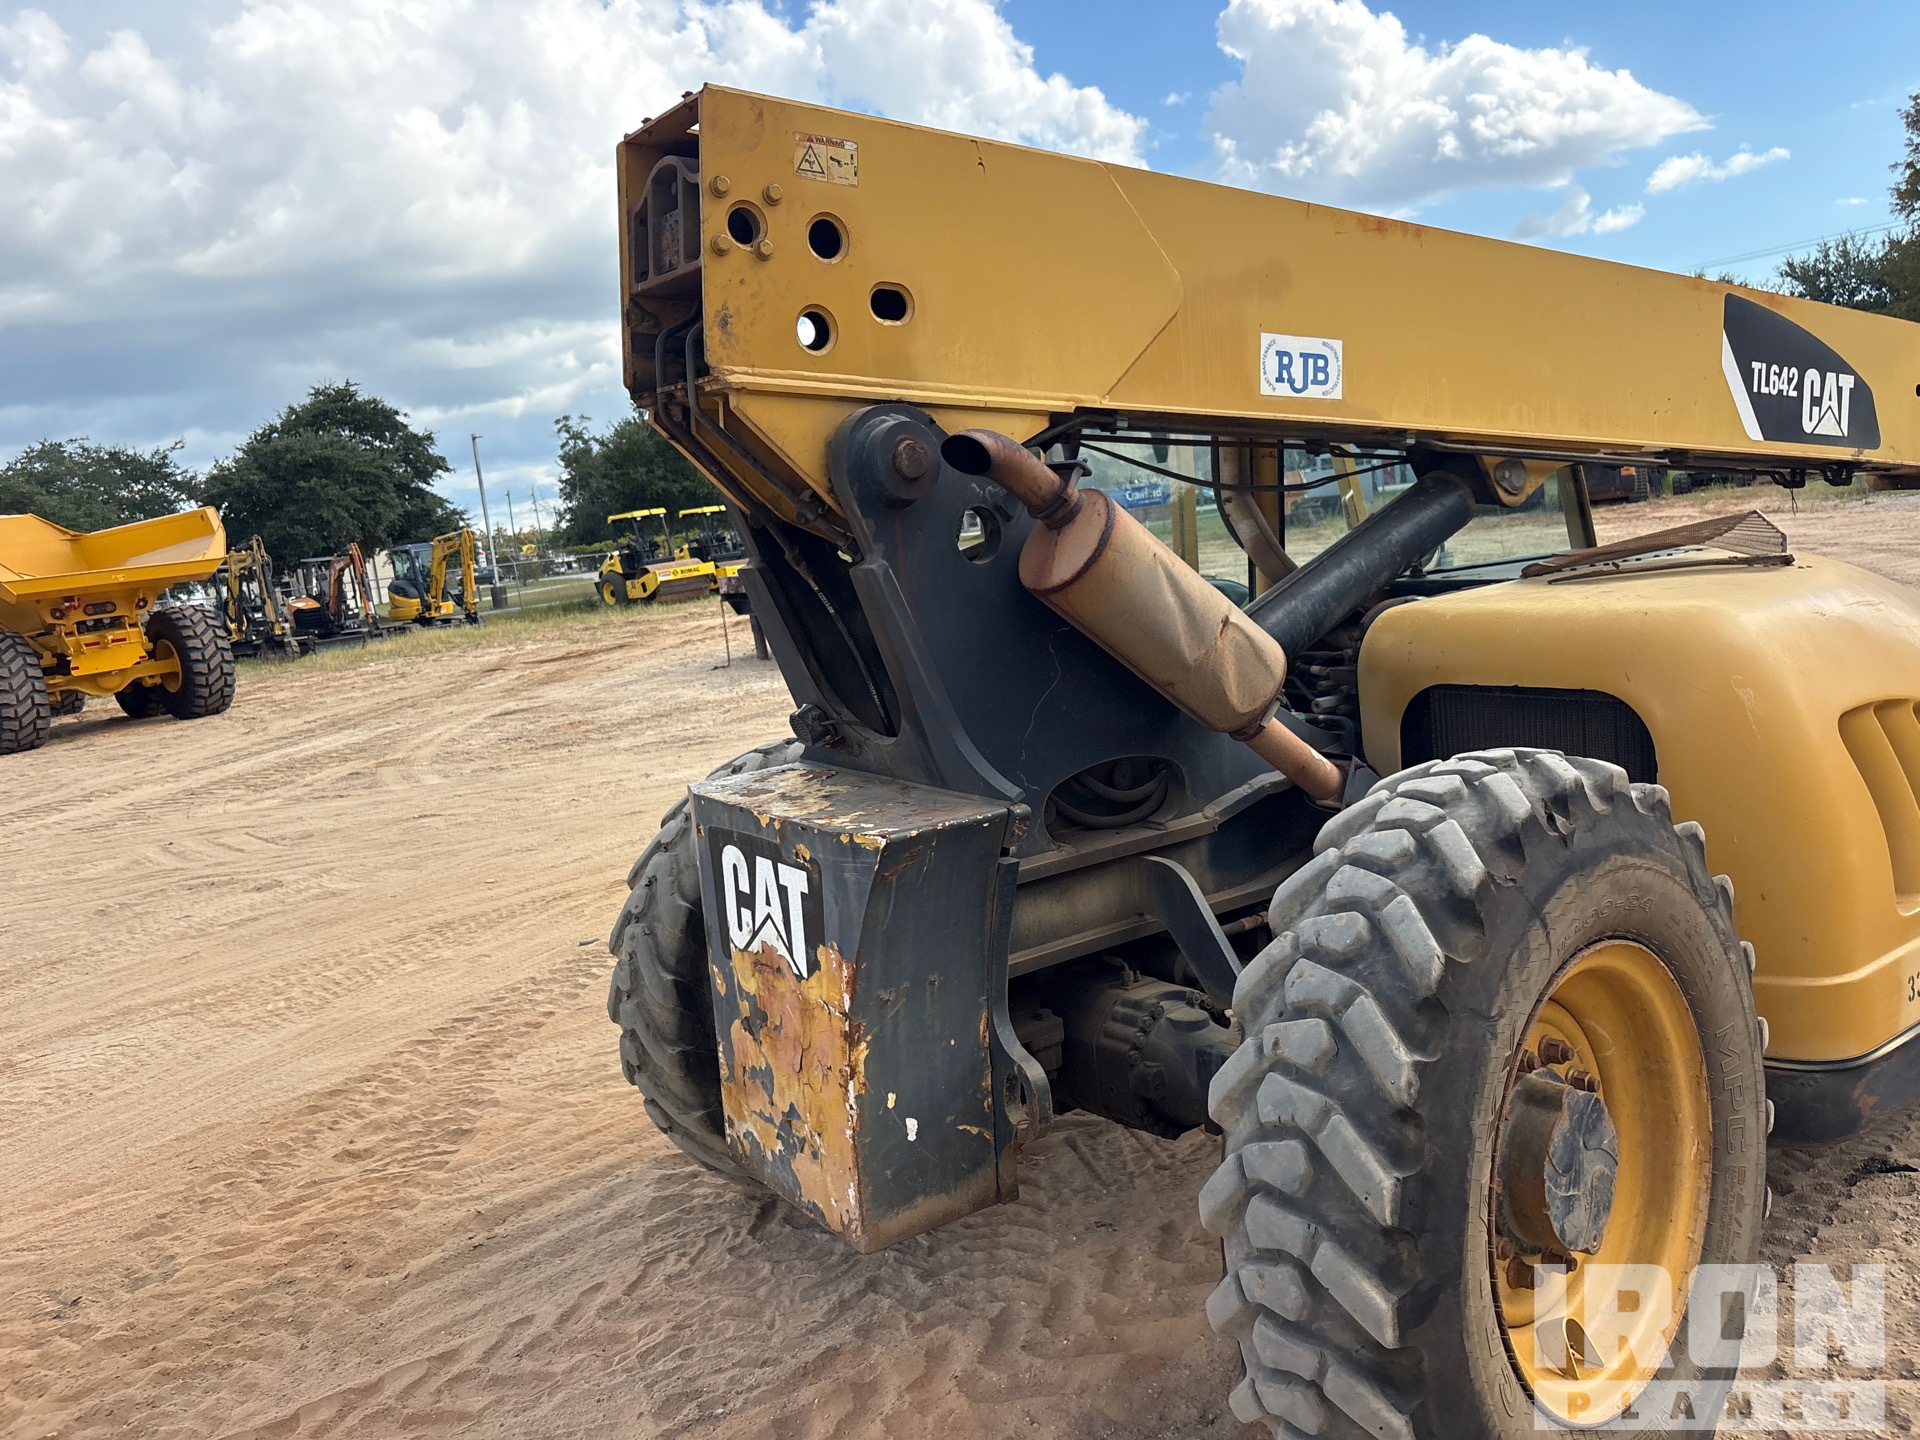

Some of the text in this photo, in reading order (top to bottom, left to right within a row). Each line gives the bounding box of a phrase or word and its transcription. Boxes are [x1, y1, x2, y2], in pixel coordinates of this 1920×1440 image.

[815, 136, 845, 148] WARNING
[1262, 339, 1276, 376] MAINTENANCE
[1275, 350, 1329, 394] RJB
[1752, 361, 1799, 397] TL642
[1802, 368, 1855, 437] CAT
[722, 844, 809, 979] CAT
[1715, 1021, 1747, 1155] MPC
